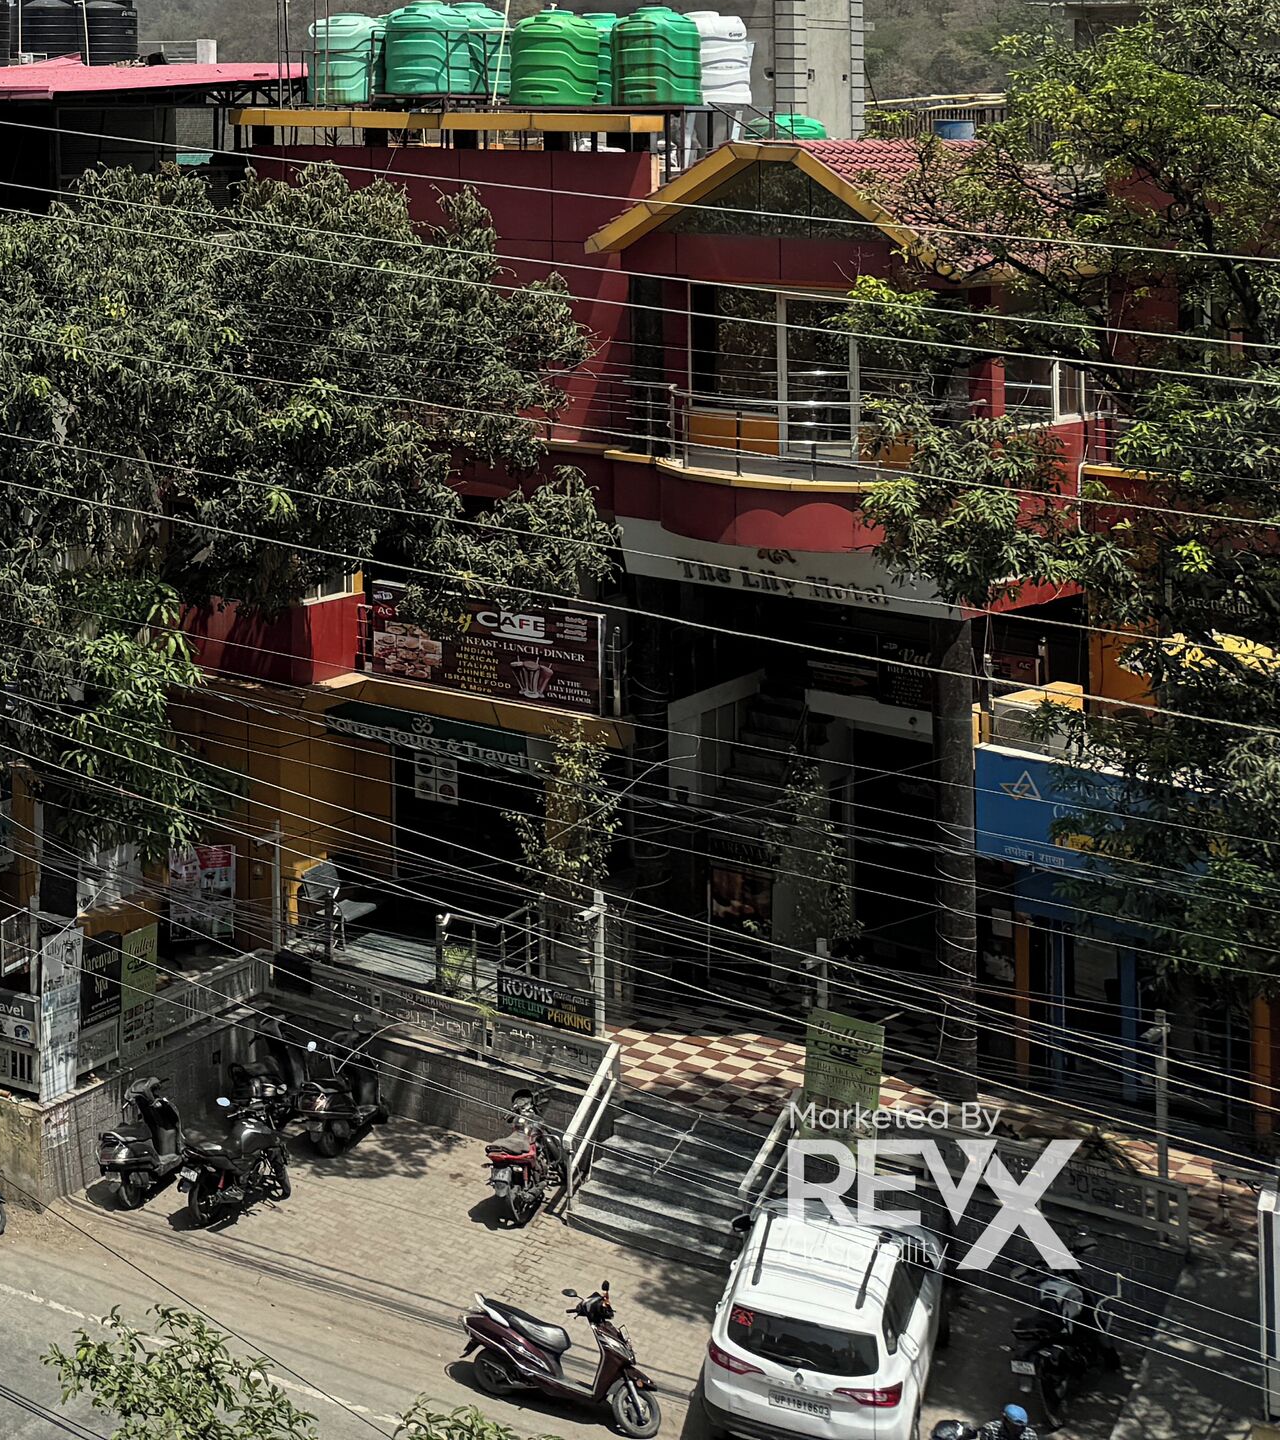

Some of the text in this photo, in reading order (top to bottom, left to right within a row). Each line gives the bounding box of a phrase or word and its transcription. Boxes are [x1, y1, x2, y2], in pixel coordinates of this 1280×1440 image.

[676, 557, 890, 605] The Lily Hotel
[377, 606, 393, 616] AC
[476, 610, 546, 639] CAFE
[455, 651, 500, 665] MEXICAN
[460, 645, 495, 657] INDIAN
[503, 642, 586, 662] LUNCH DINNER
[456, 667, 499, 680] CHINESE
[458, 660, 497, 673] ITALIAN
[444, 672, 512, 690] ISRAELI FOOD
[468, 683, 493, 694] More
[557, 678, 581, 688] IN THE
[546, 691, 592, 705] ON FLOOR
[565, 686, 590, 697] HOTEL
[325, 714, 528, 769] Sohan Tours & Travel
[128, 937, 155, 955] Valley
[82, 949, 120, 973] Varenyam
[94, 977, 110, 999] Spa
[502, 976, 553, 1005] ROOMS
[415, 994, 452, 1010] PARKING
[502, 994, 526, 1010] HOTEL
[547, 1008, 592, 1032] PARKING
